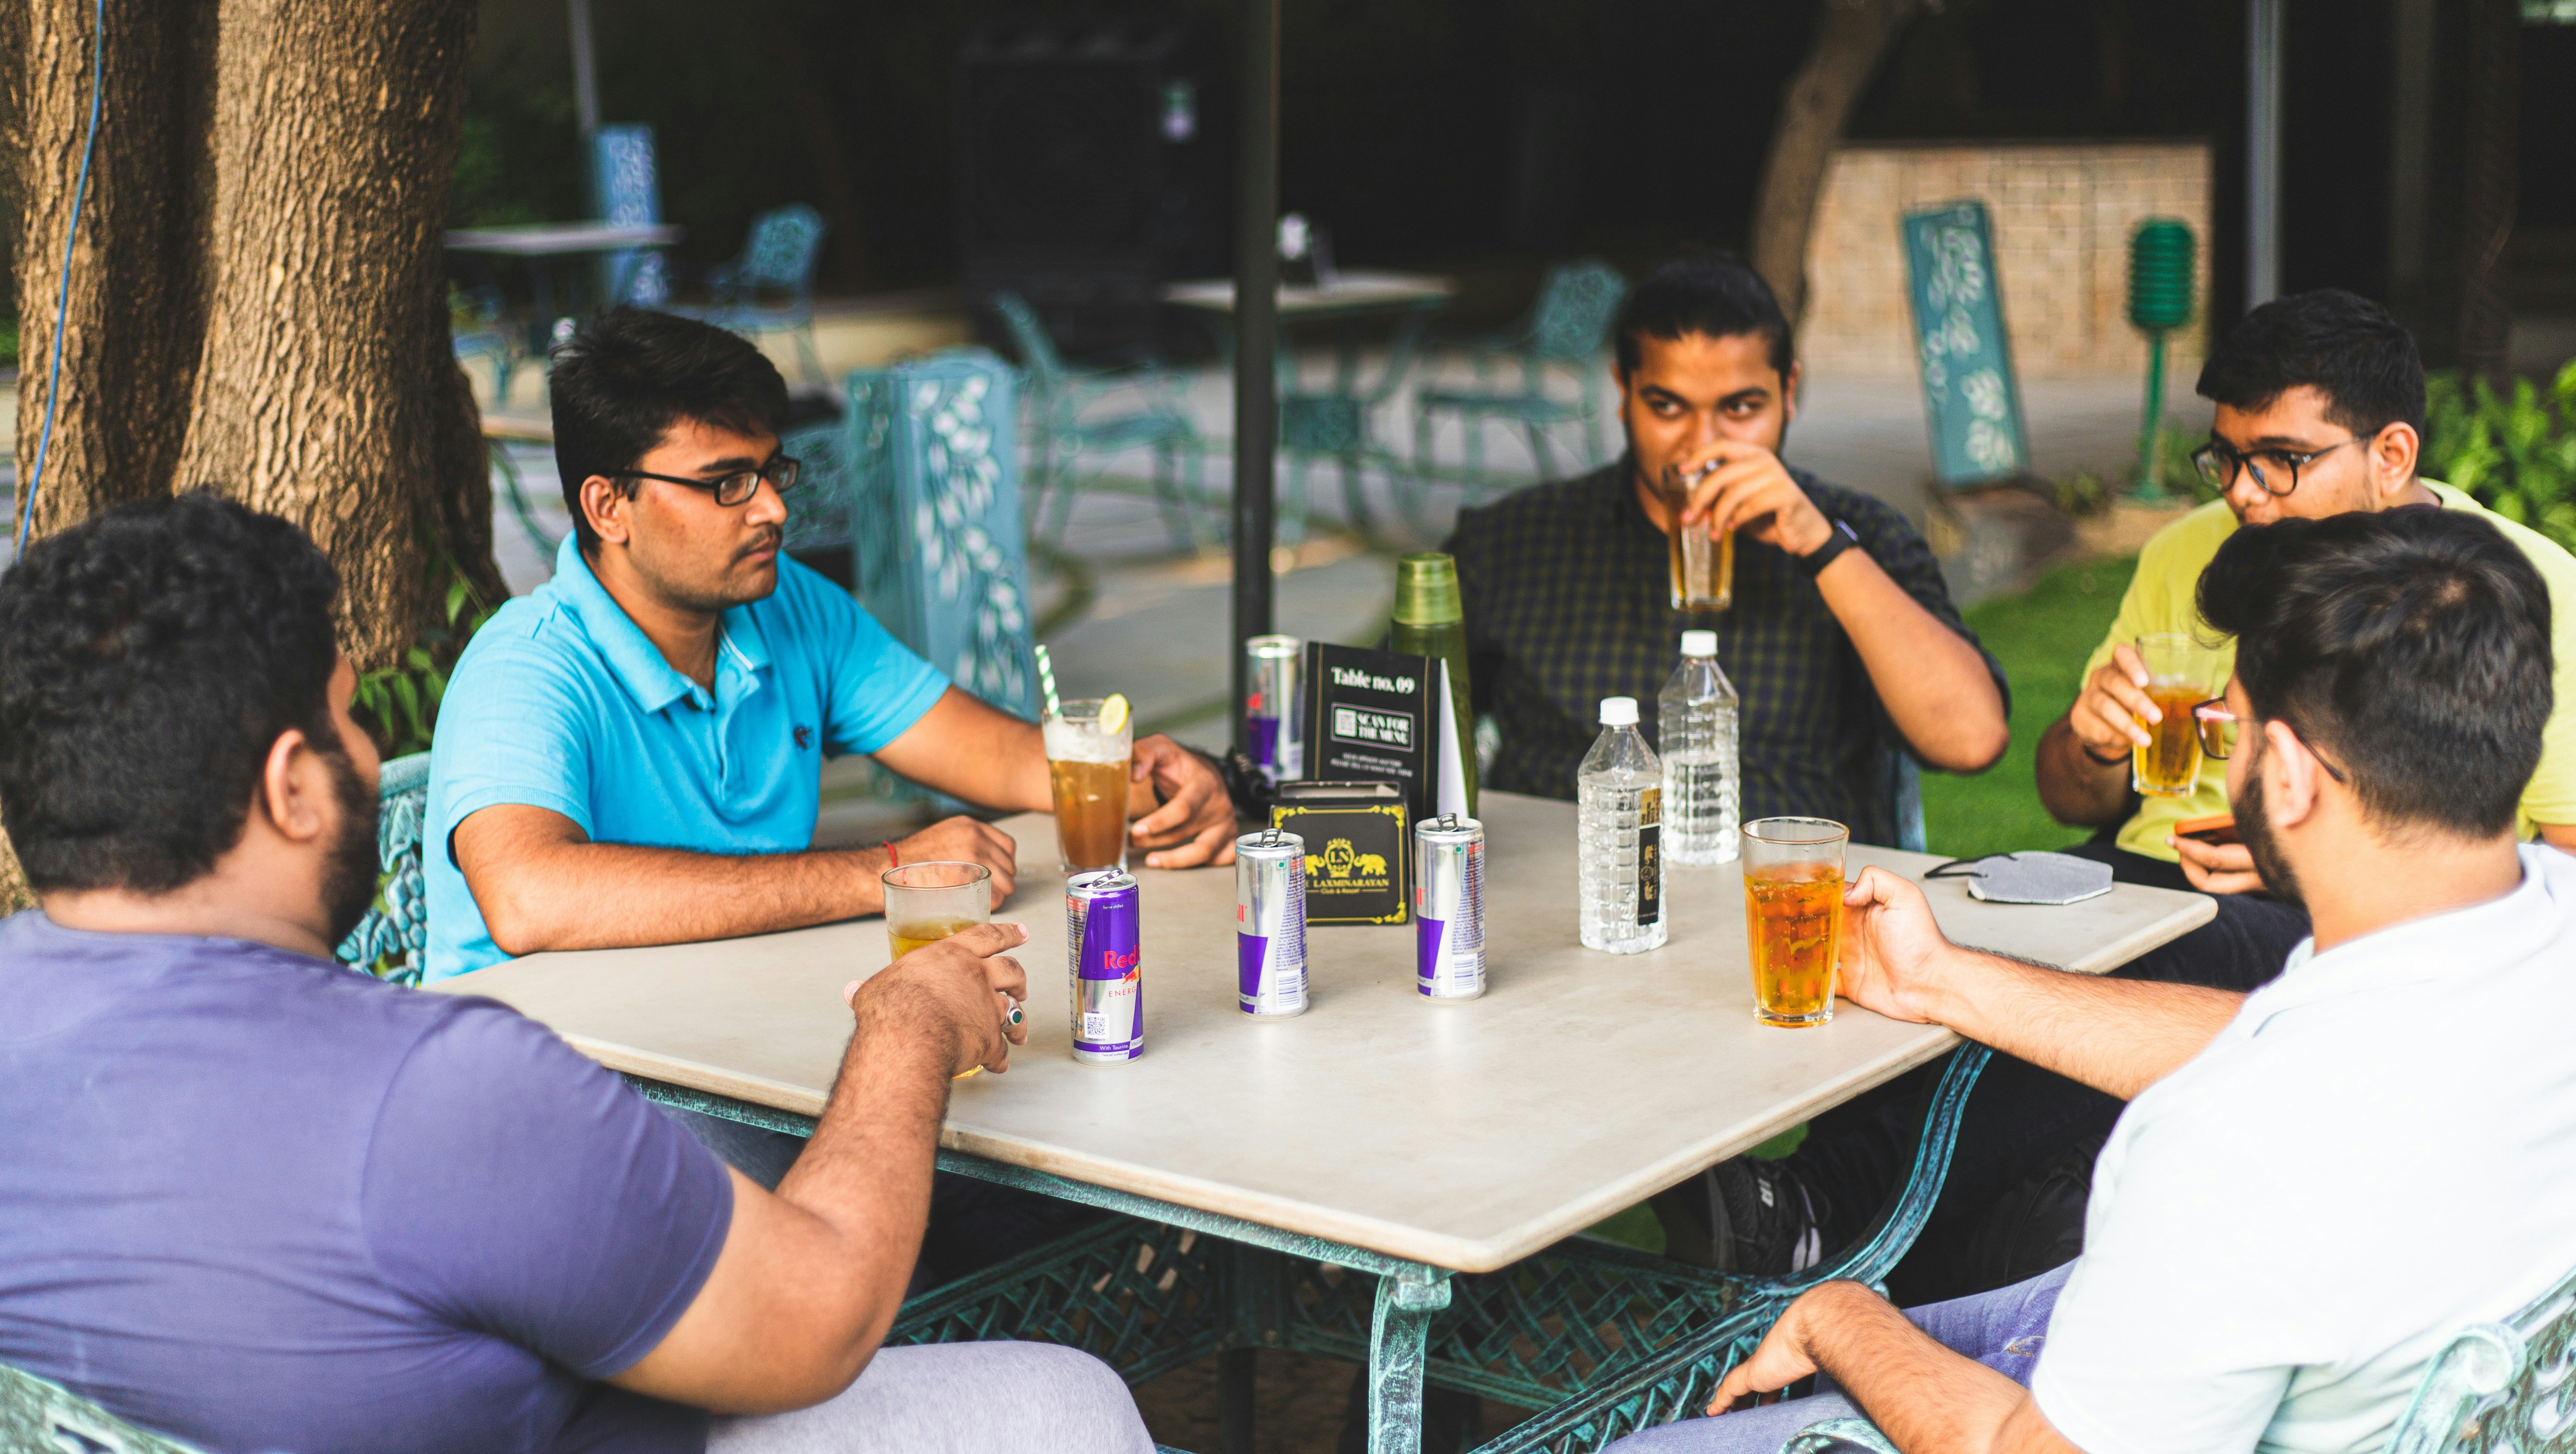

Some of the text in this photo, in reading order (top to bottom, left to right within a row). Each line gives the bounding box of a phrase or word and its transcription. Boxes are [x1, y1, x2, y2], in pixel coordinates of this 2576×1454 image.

[1331, 666, 1415, 694] Table no. 09
[1357, 712, 1409, 732] SCAN FOR
[1358, 726, 1409, 745] THE MENU
[1313, 878, 1390, 887] LAXMINARAYAN
[1104, 945, 1137, 969] Red
